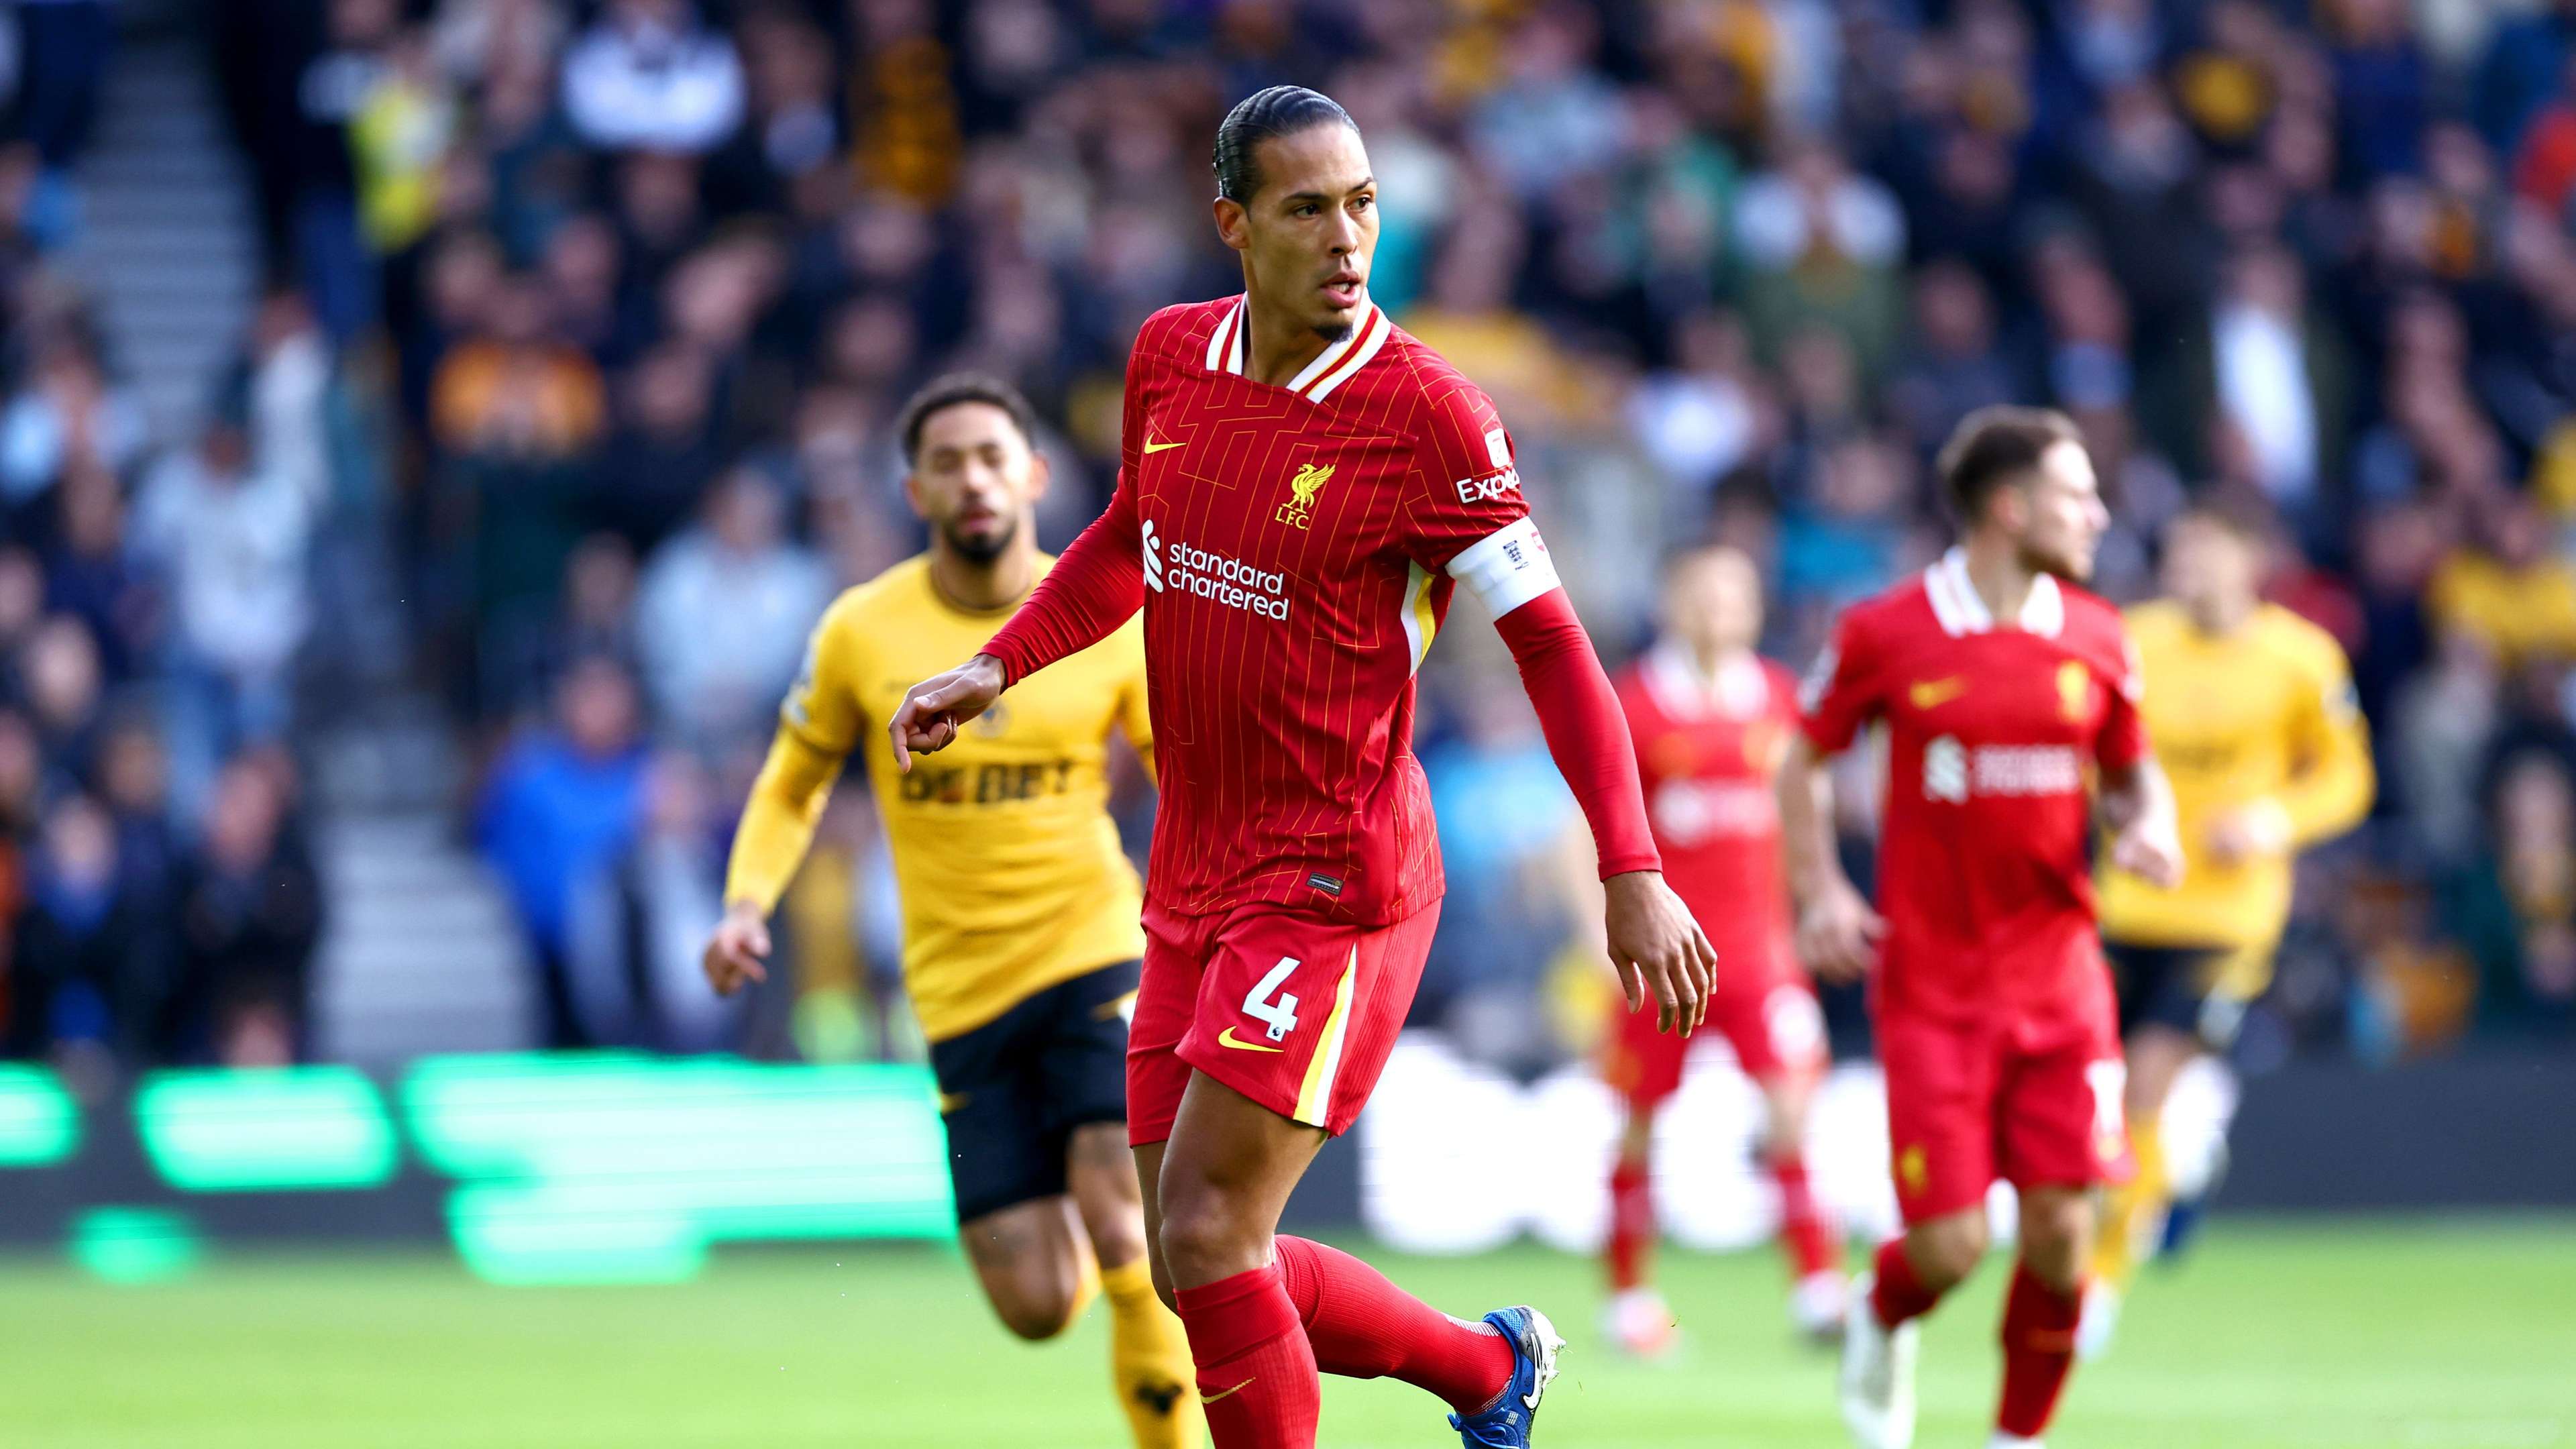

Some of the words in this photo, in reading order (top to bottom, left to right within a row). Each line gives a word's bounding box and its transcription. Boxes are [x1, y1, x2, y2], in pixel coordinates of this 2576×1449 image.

[1168, 567, 1289, 621] chartered
[1169, 542, 1284, 595] standard
[1242, 956, 1301, 1042] 4
